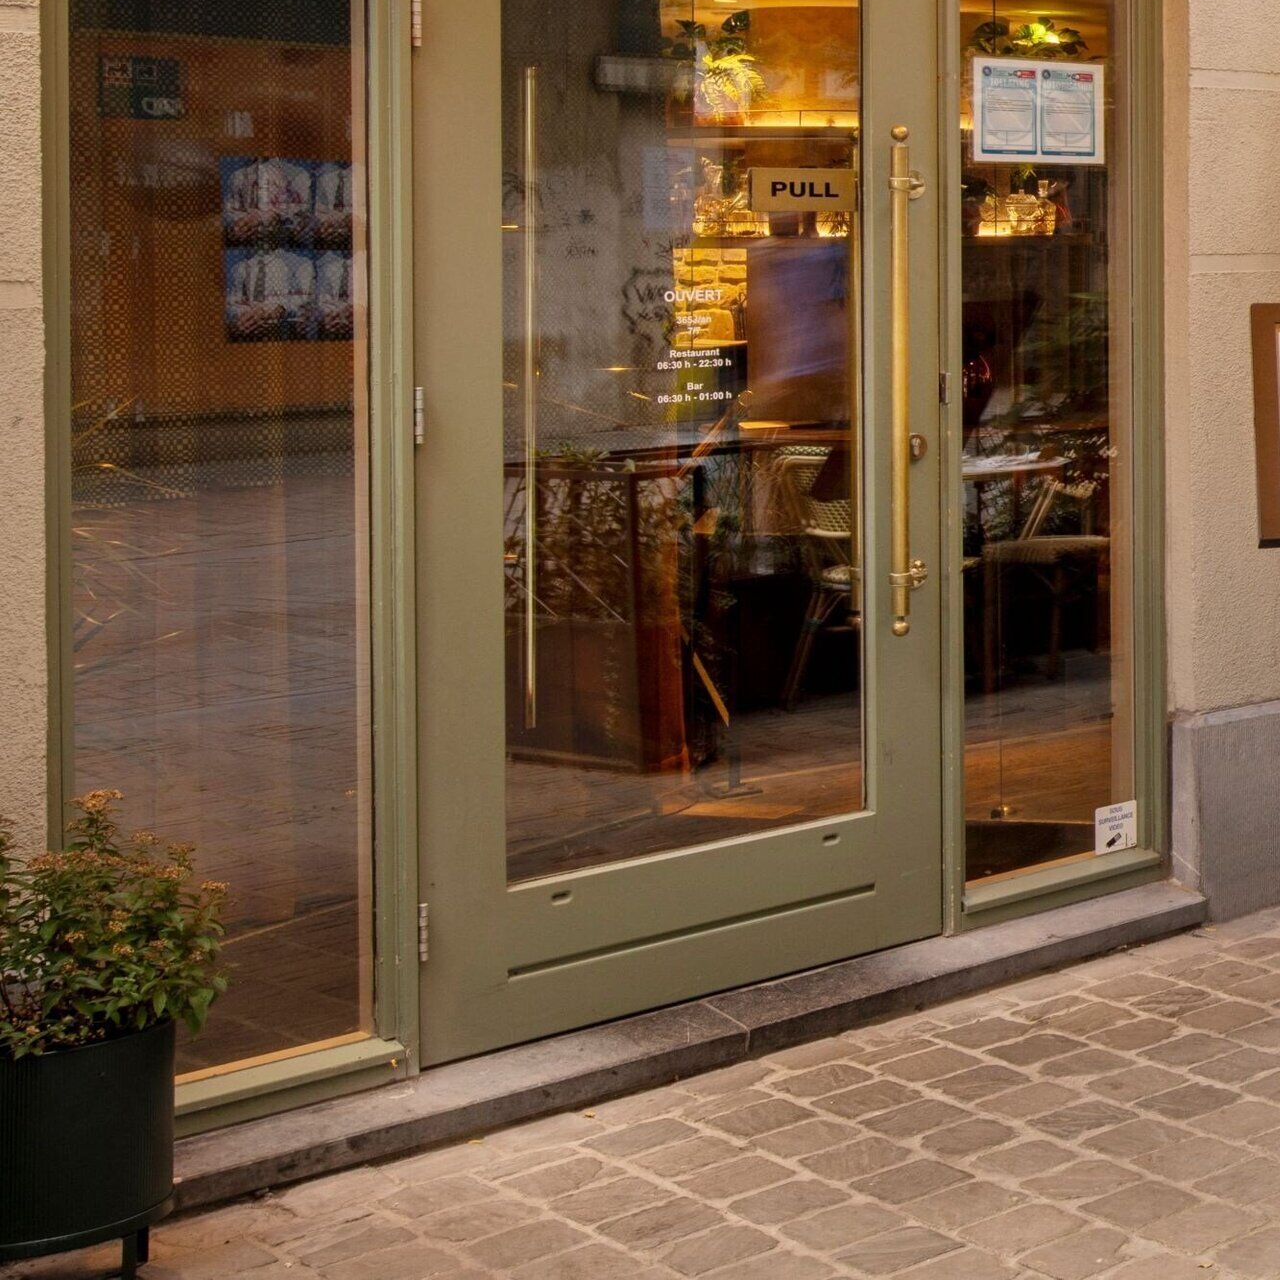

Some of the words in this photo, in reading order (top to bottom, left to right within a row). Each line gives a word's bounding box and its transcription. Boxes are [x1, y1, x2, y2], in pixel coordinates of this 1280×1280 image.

[771, 181, 839, 198] PULL
[663, 289, 723, 303] OUVERT
[669, 348, 720, 359] Restaurant
[657, 361, 682, 370] 06:30
[684, 360, 691, 369] h
[699, 359, 723, 368] 22:30
[725, 358, 732, 367] h
[687, 382, 704, 391] Bar
[657, 394, 683, 404] 06:30
[684, 393, 691, 402] h
[699, 392, 724, 401] 01:00
[725, 391, 732, 400] h
